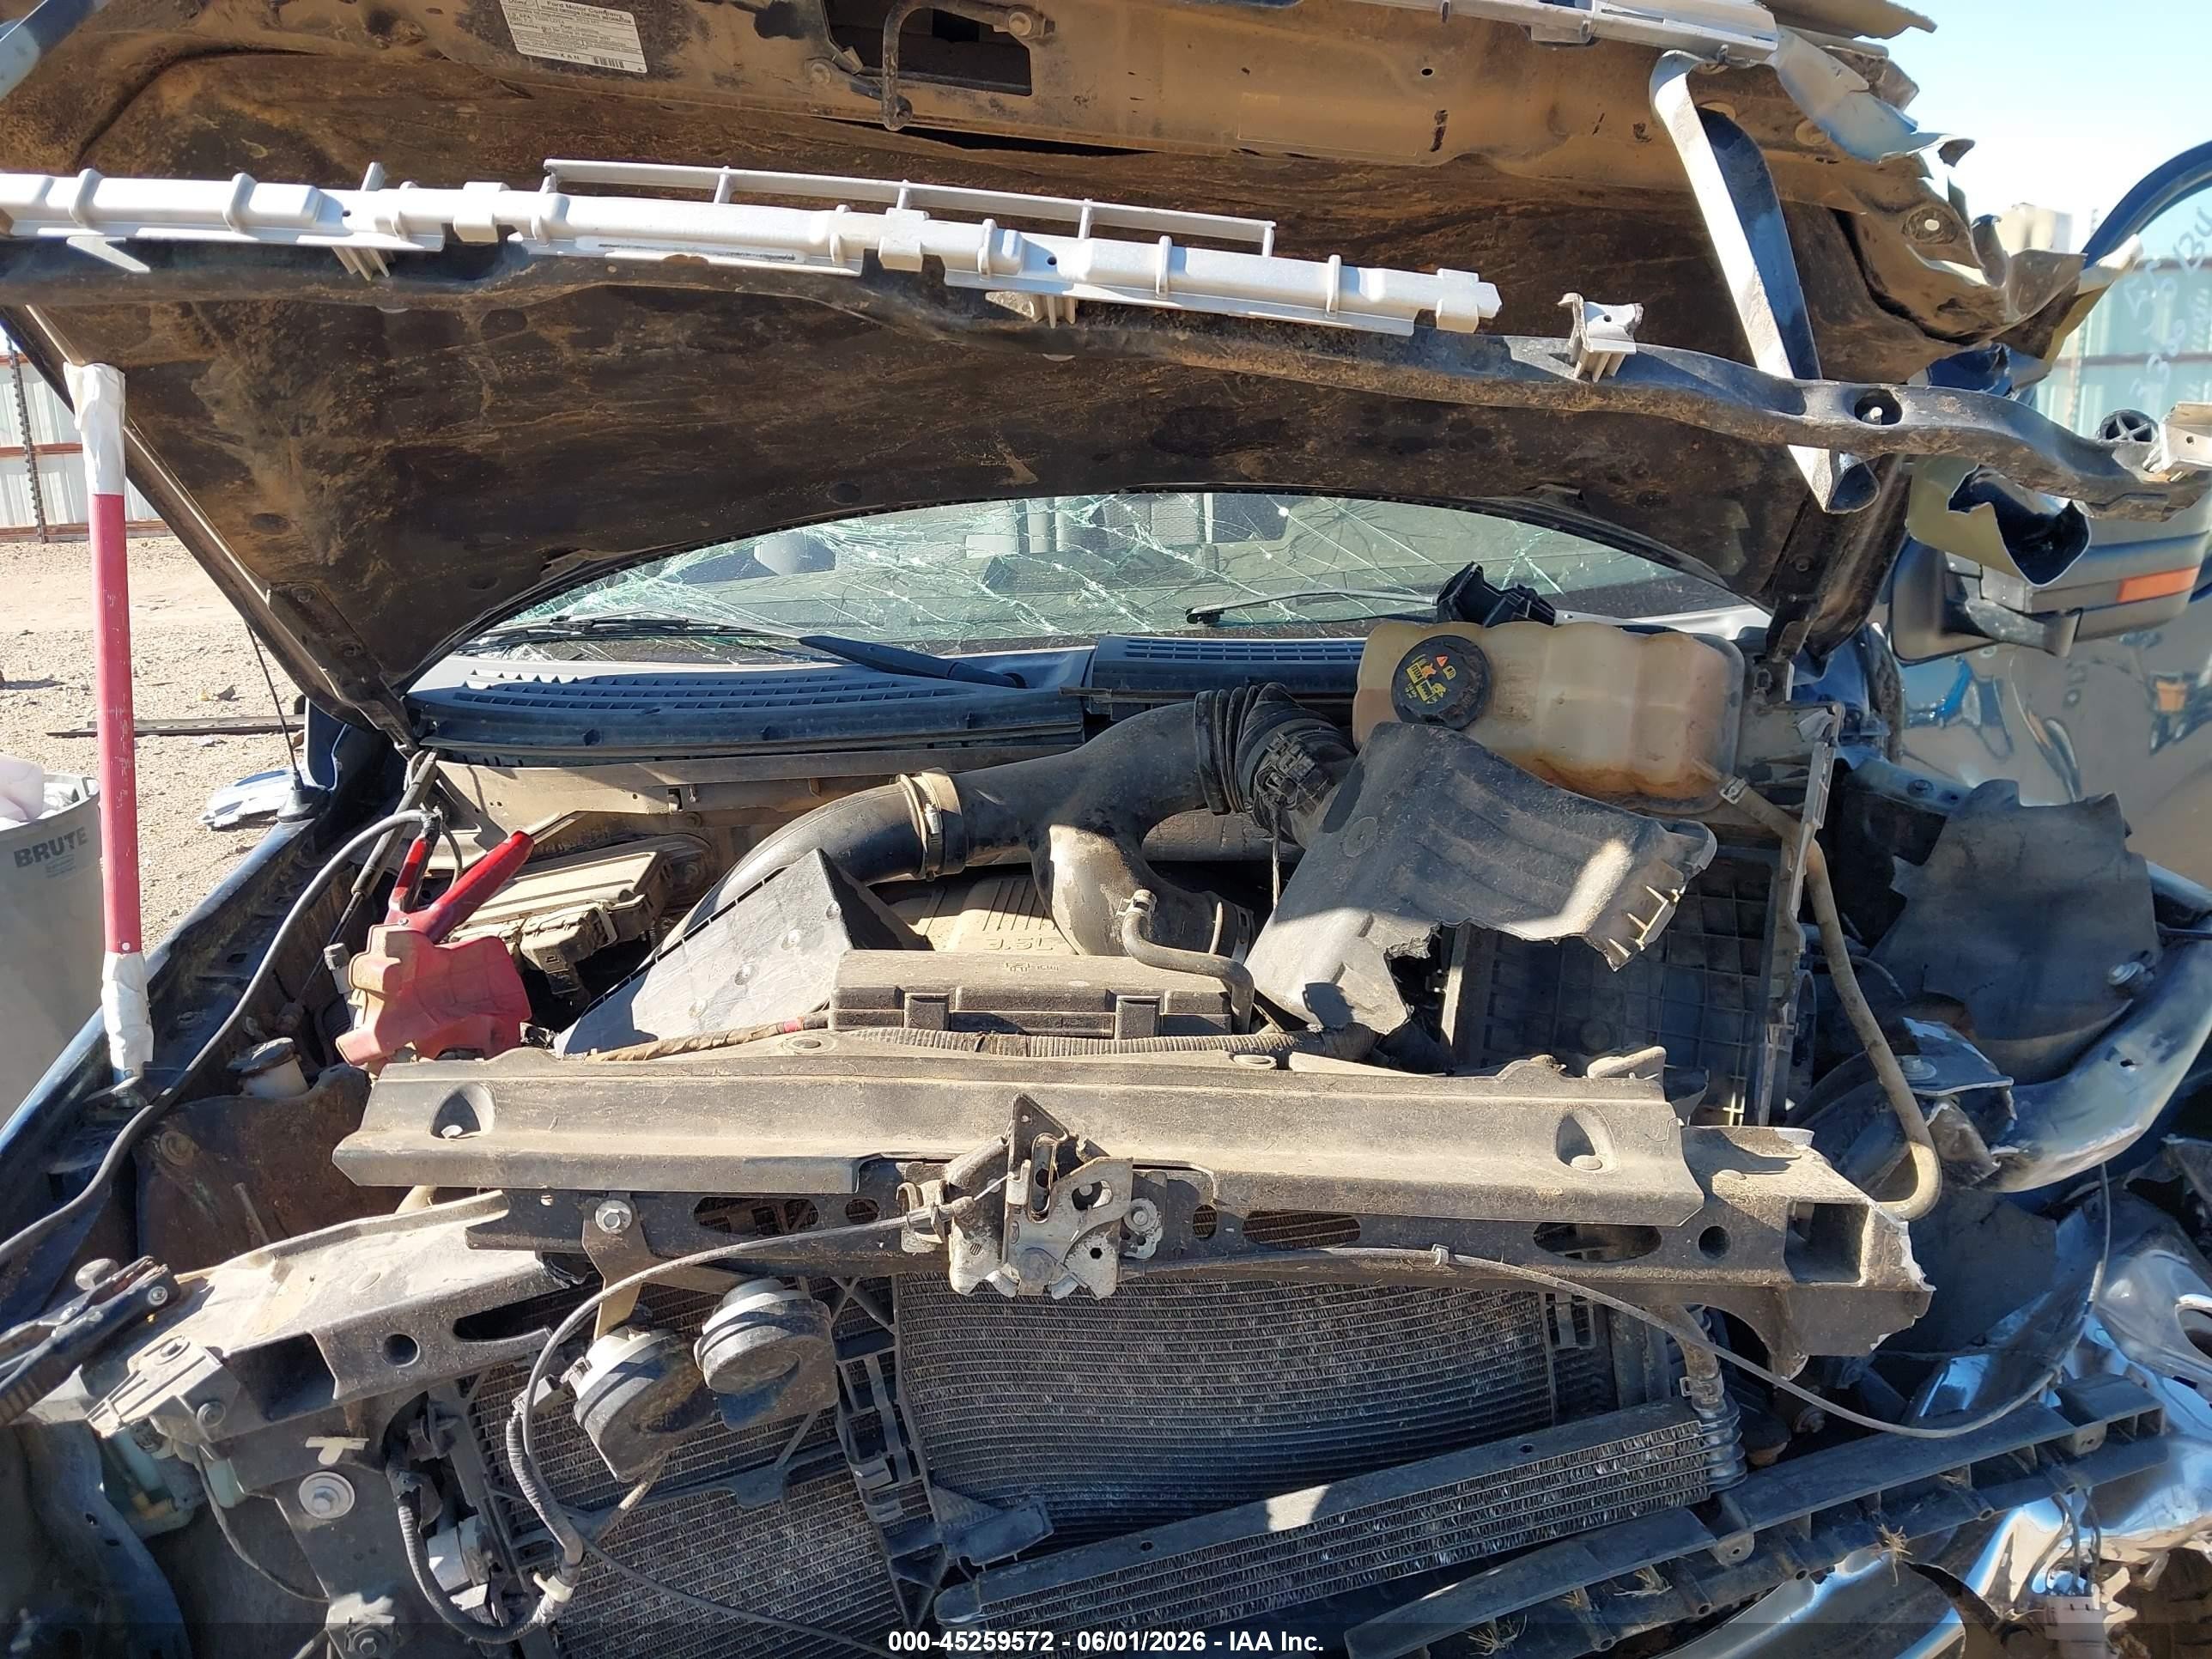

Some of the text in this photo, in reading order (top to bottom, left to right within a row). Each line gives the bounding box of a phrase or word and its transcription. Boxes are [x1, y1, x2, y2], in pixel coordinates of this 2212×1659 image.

[588, 7, 623, 18] Company
[14, 826, 88, 868] BRUTE
[983, 936, 1054, 951] 3.5L
